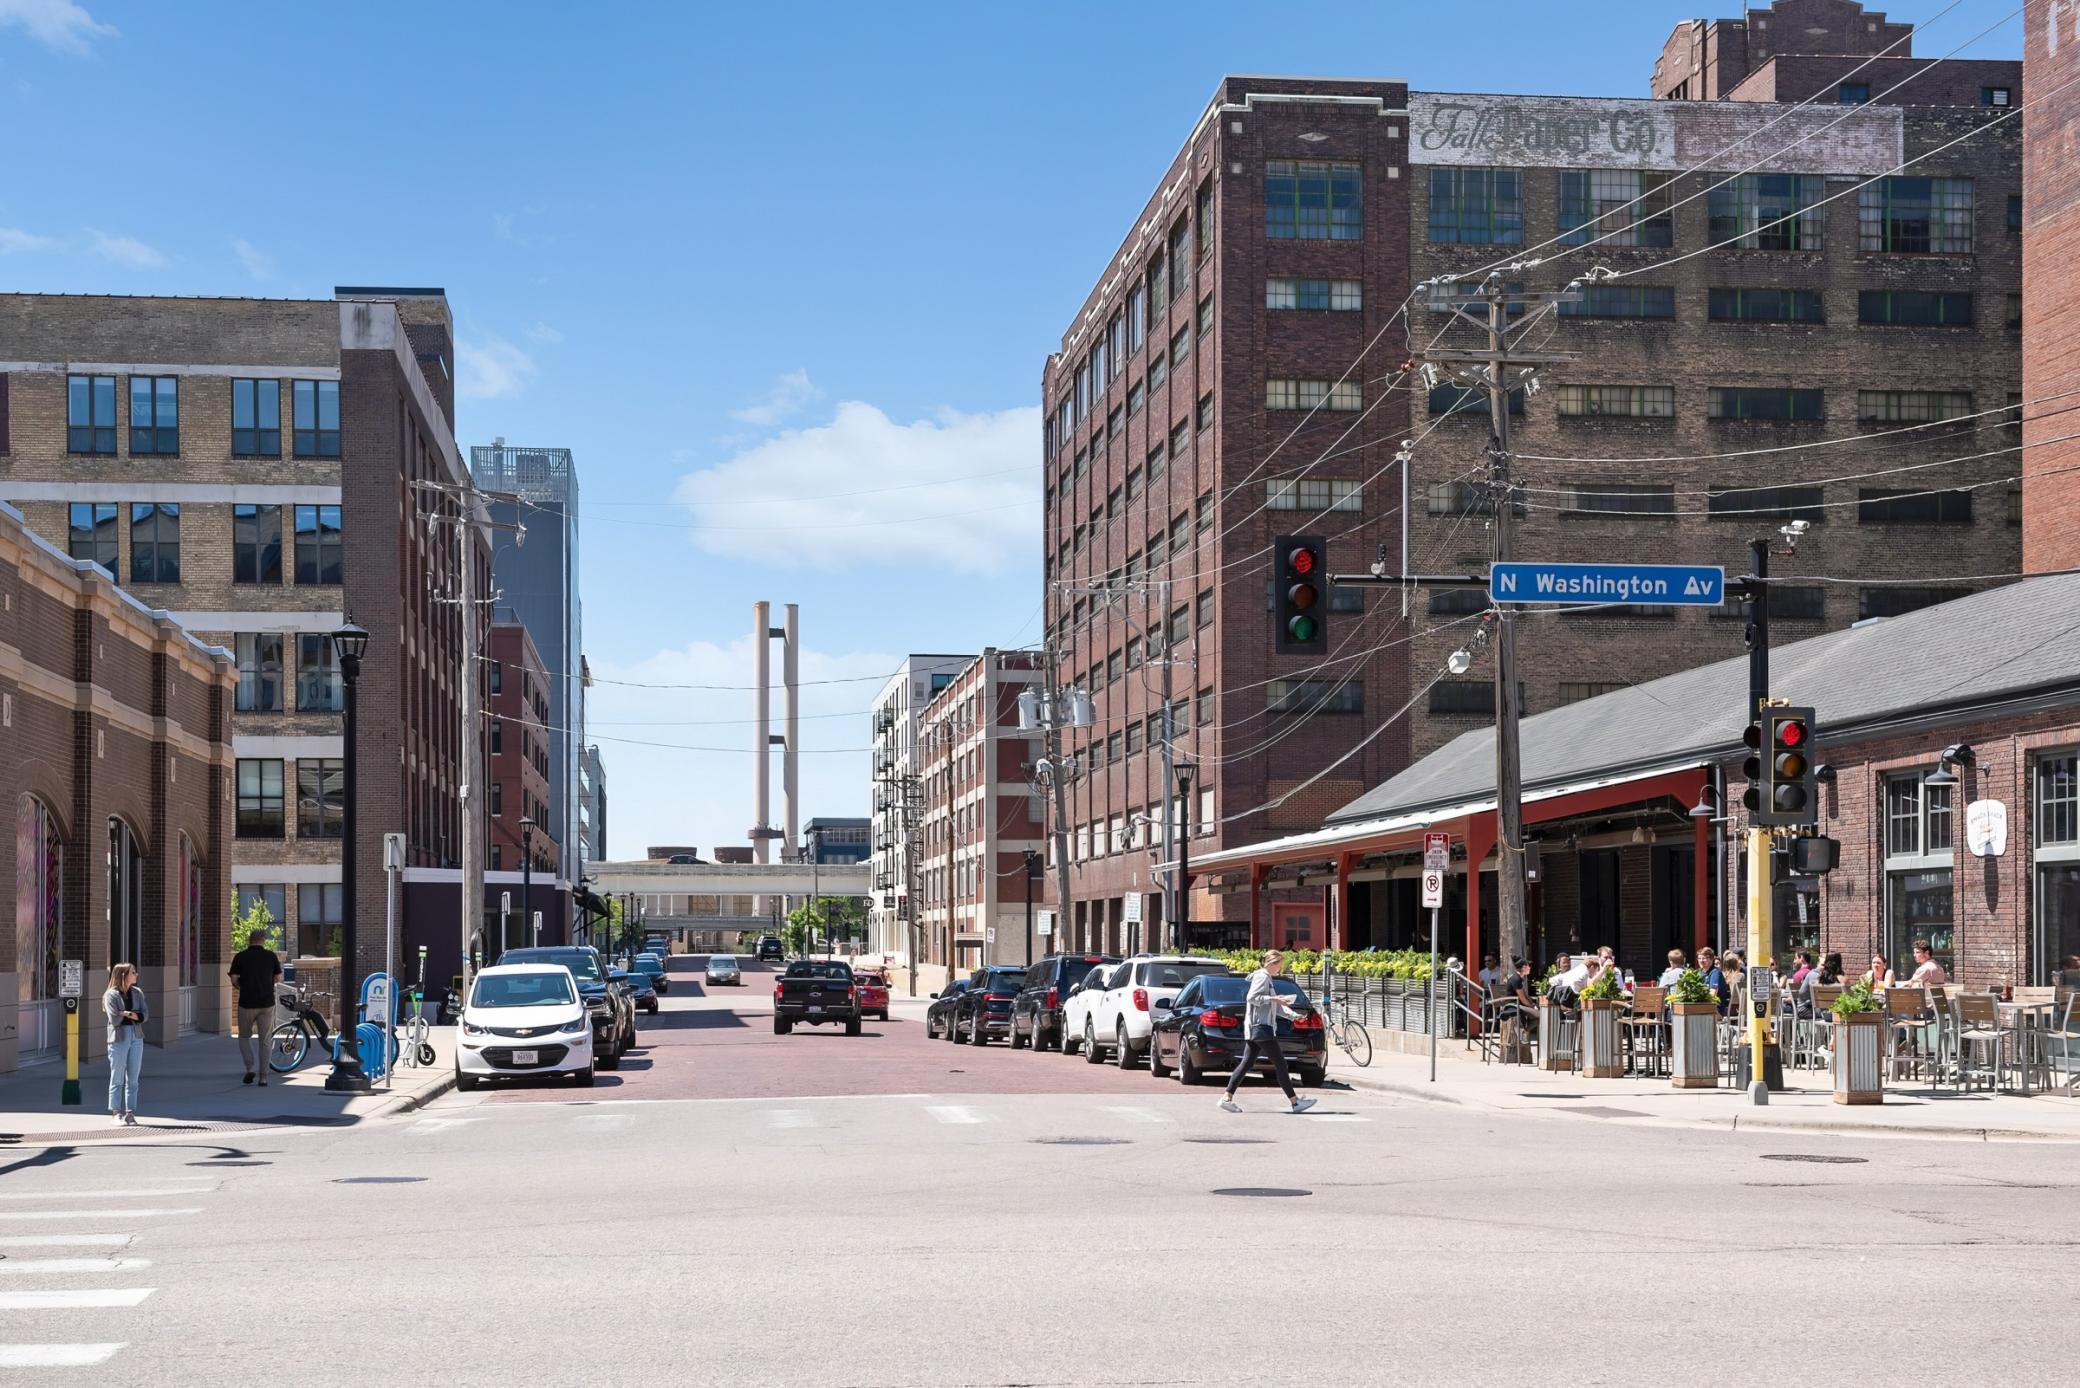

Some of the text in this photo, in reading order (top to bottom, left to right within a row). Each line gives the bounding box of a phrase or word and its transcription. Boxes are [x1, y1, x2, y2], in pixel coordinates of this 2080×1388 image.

[1419, 102, 1496, 151] Falk
[1500, 573, 1713, 600] N Washington Av
